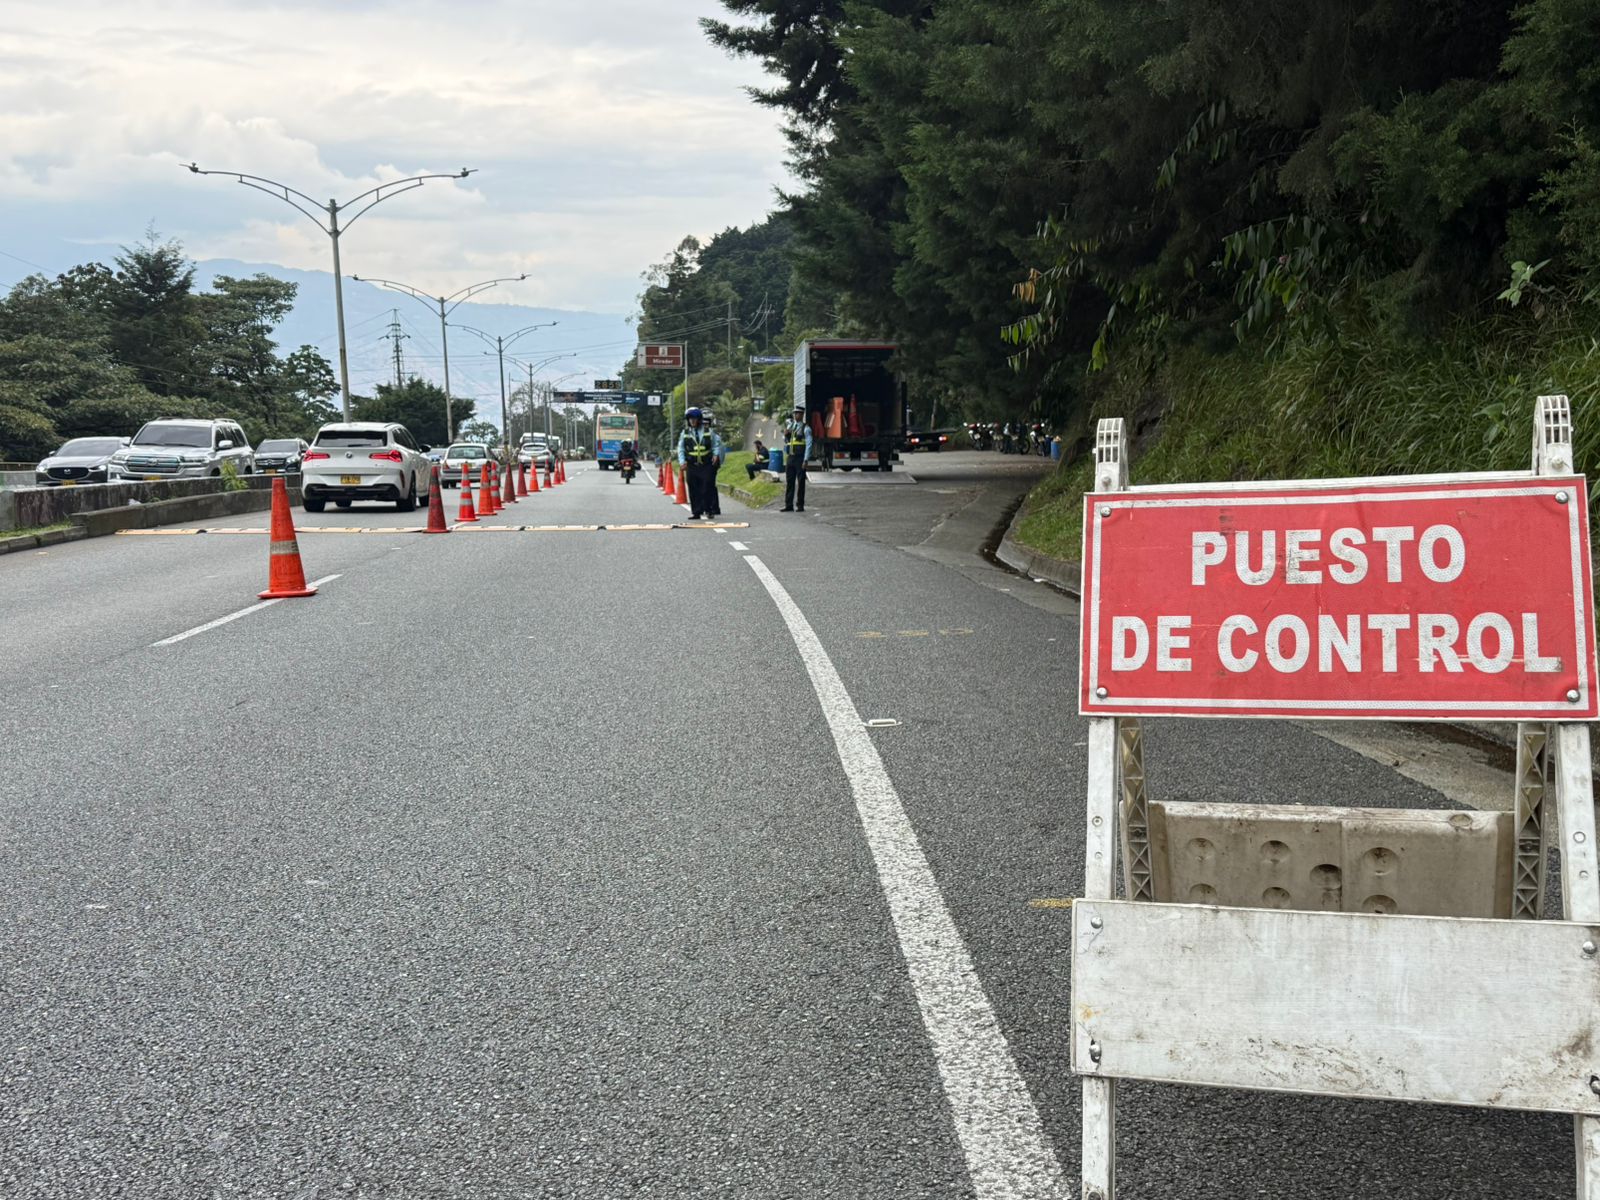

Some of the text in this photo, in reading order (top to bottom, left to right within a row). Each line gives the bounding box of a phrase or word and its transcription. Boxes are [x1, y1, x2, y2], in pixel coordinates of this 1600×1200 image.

[1191, 525, 1466, 586] PUESTO
[1110, 612, 1563, 674] DE CONTROL
